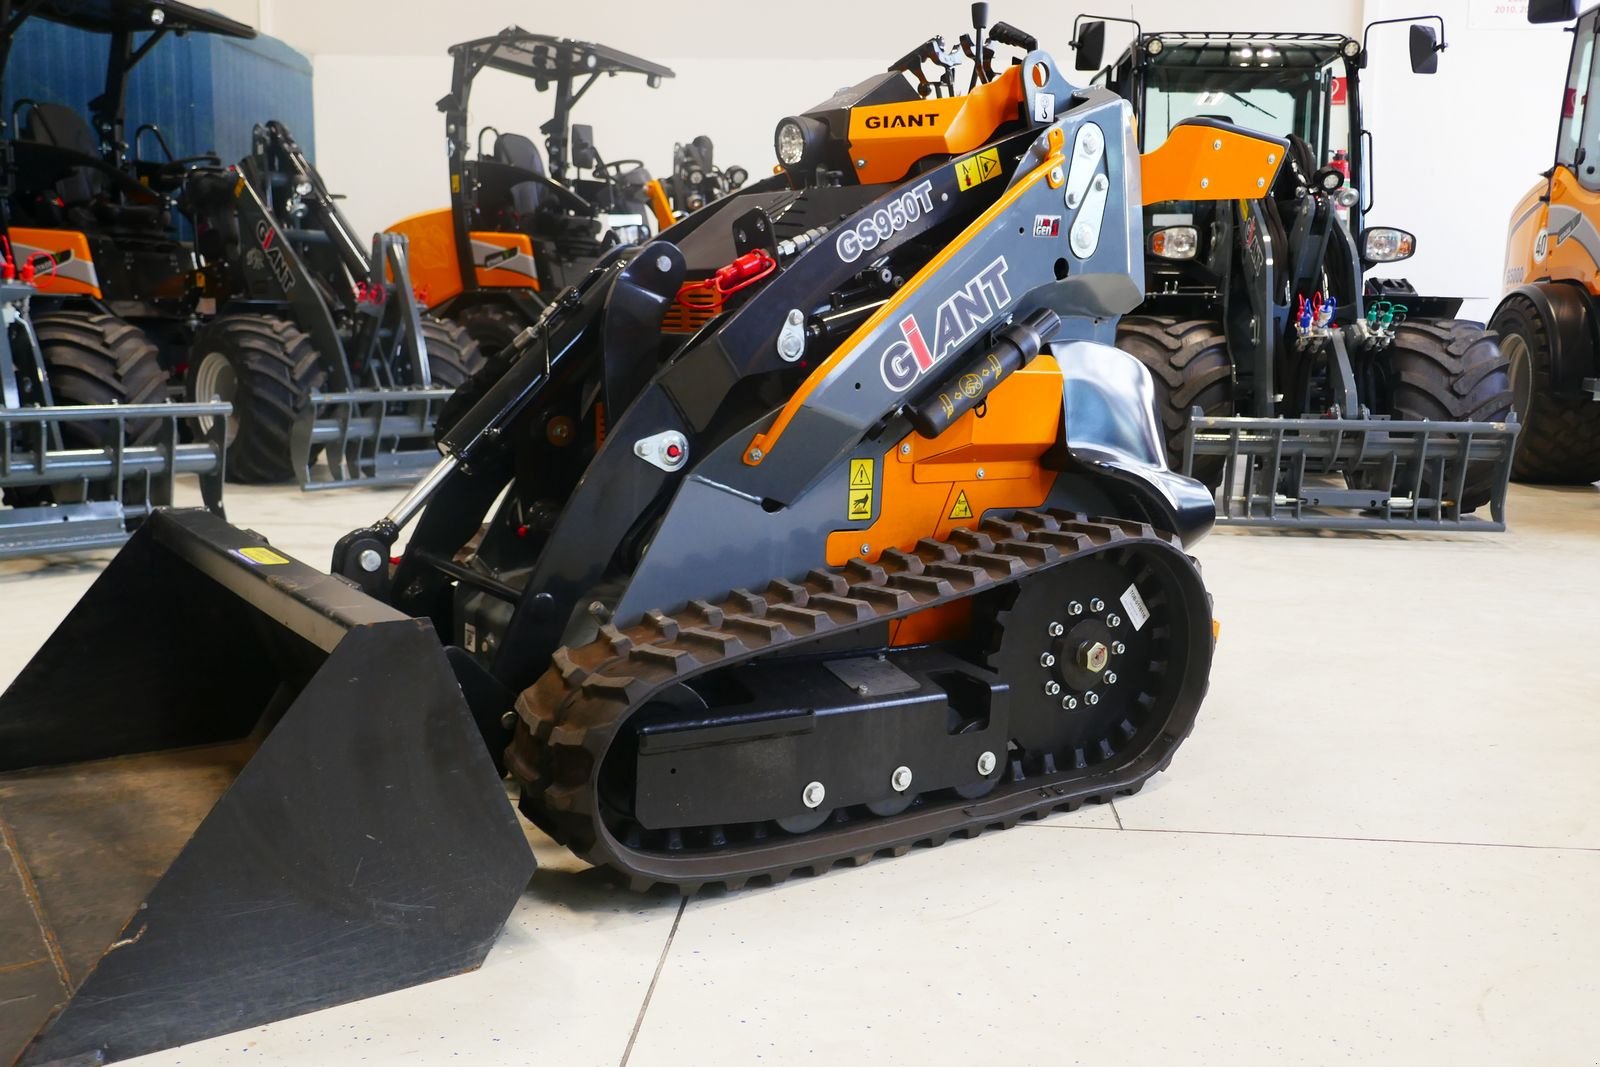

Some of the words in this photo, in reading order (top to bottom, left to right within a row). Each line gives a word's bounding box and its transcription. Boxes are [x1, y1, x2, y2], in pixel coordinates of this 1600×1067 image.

[865, 113, 940, 129] GIANT
[837, 180, 934, 263] GS950T
[1535, 233, 1547, 256] 40
